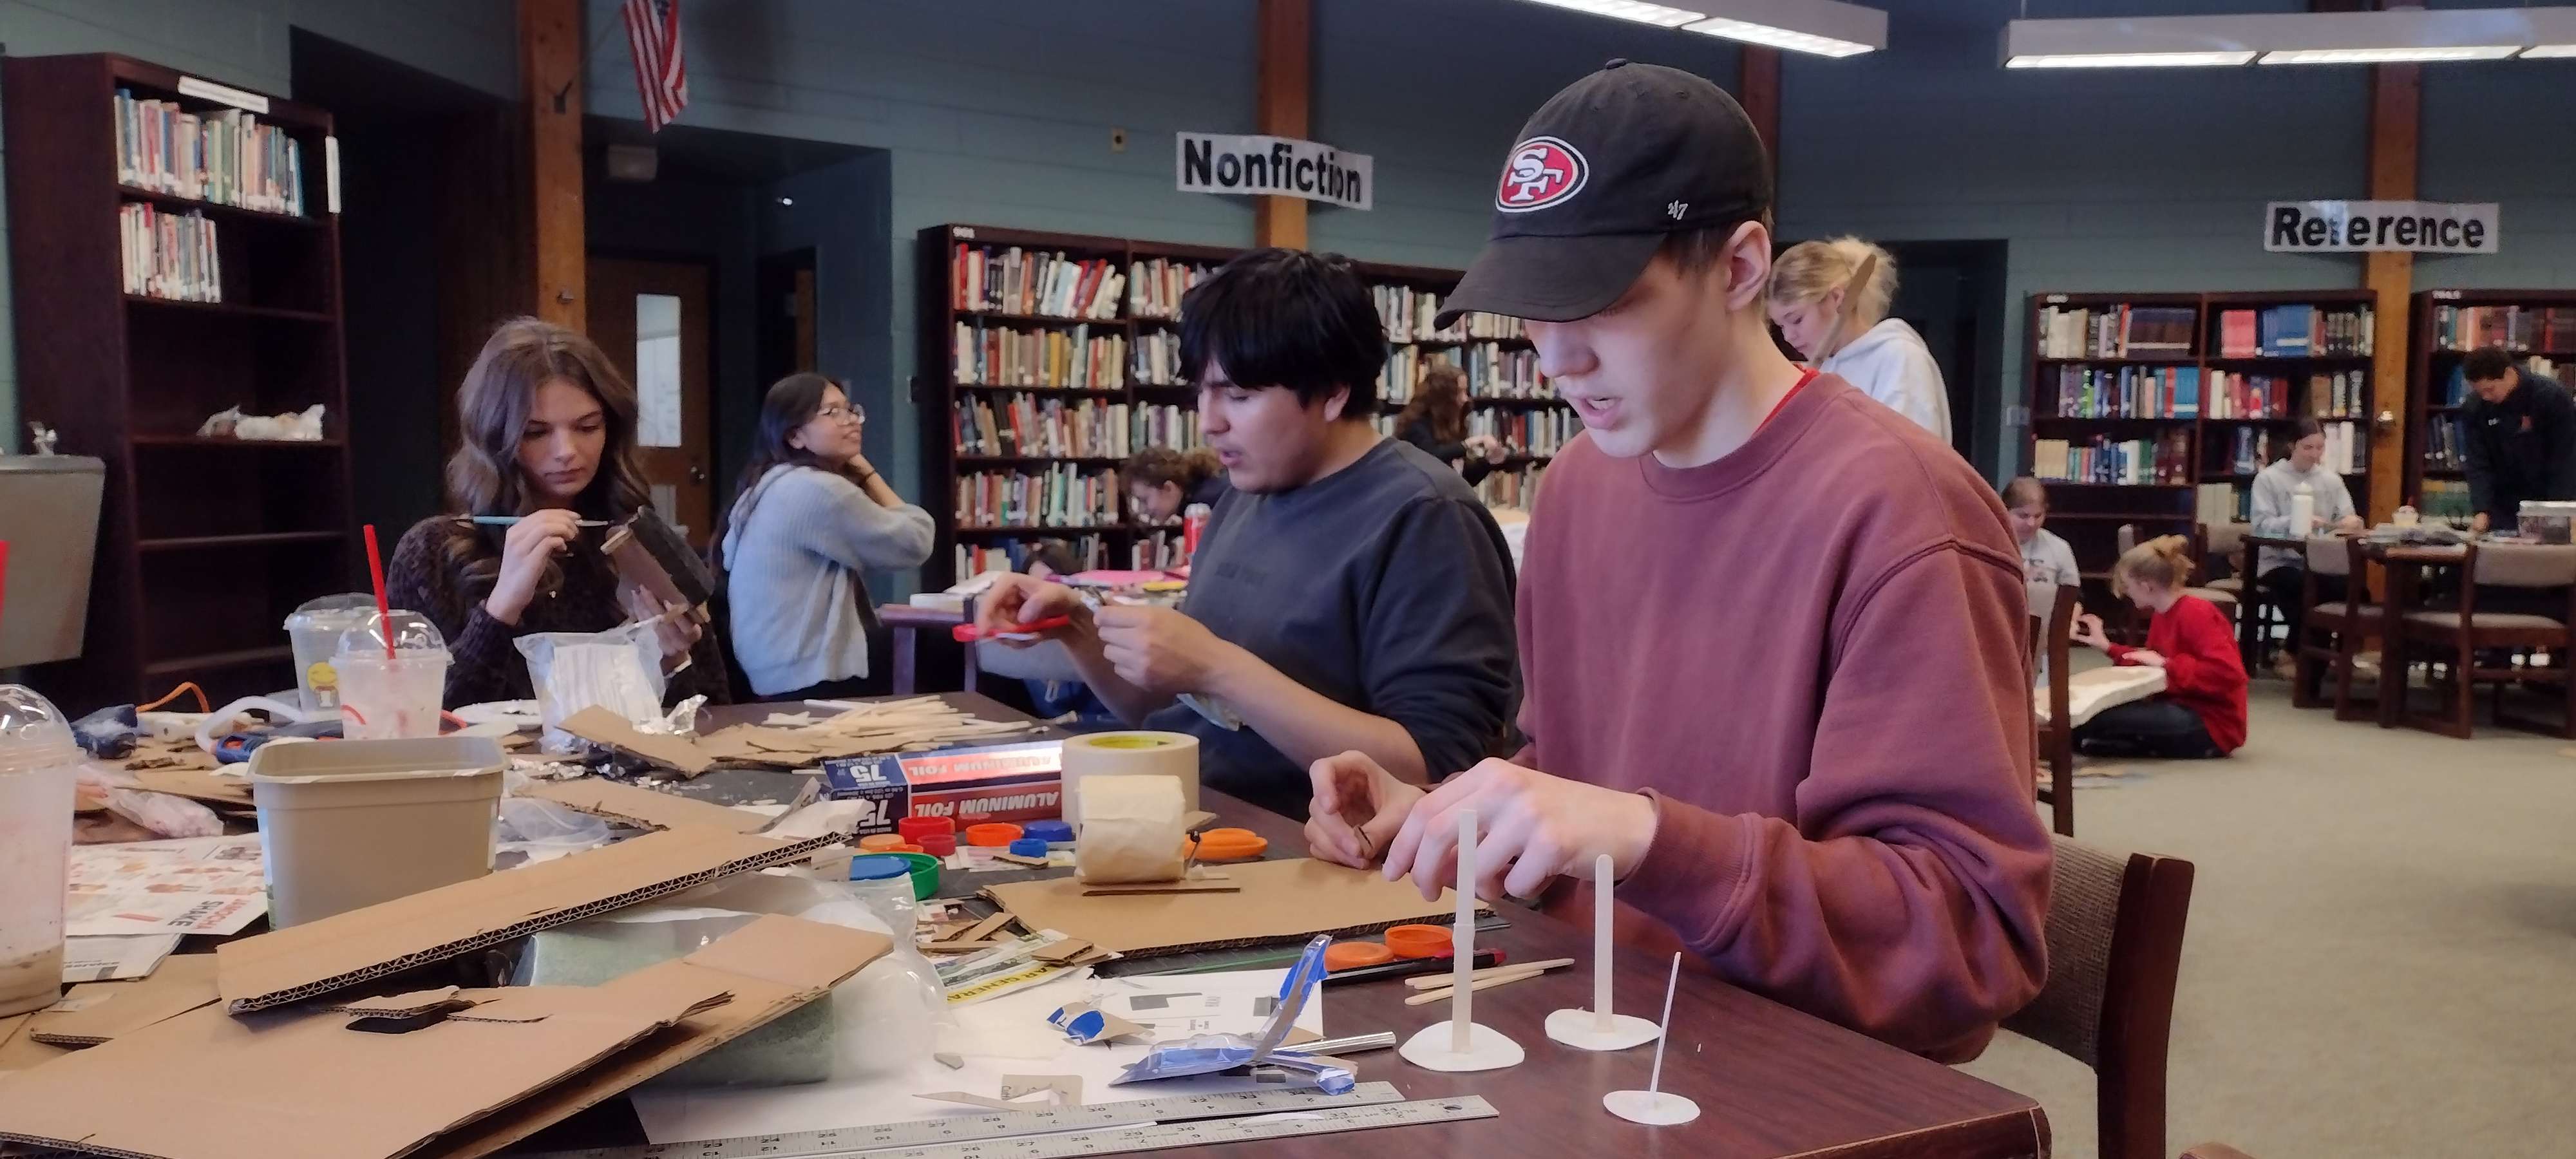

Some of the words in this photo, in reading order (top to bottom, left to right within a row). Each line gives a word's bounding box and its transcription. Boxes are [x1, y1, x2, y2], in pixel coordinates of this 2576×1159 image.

[1184, 138, 1361, 203] Nonfiction
[850, 764, 887, 783] 75
[908, 764, 948, 777] FOIL
[914, 800, 954, 818] FOIL
[958, 791, 1059, 815] ALUMINUM
